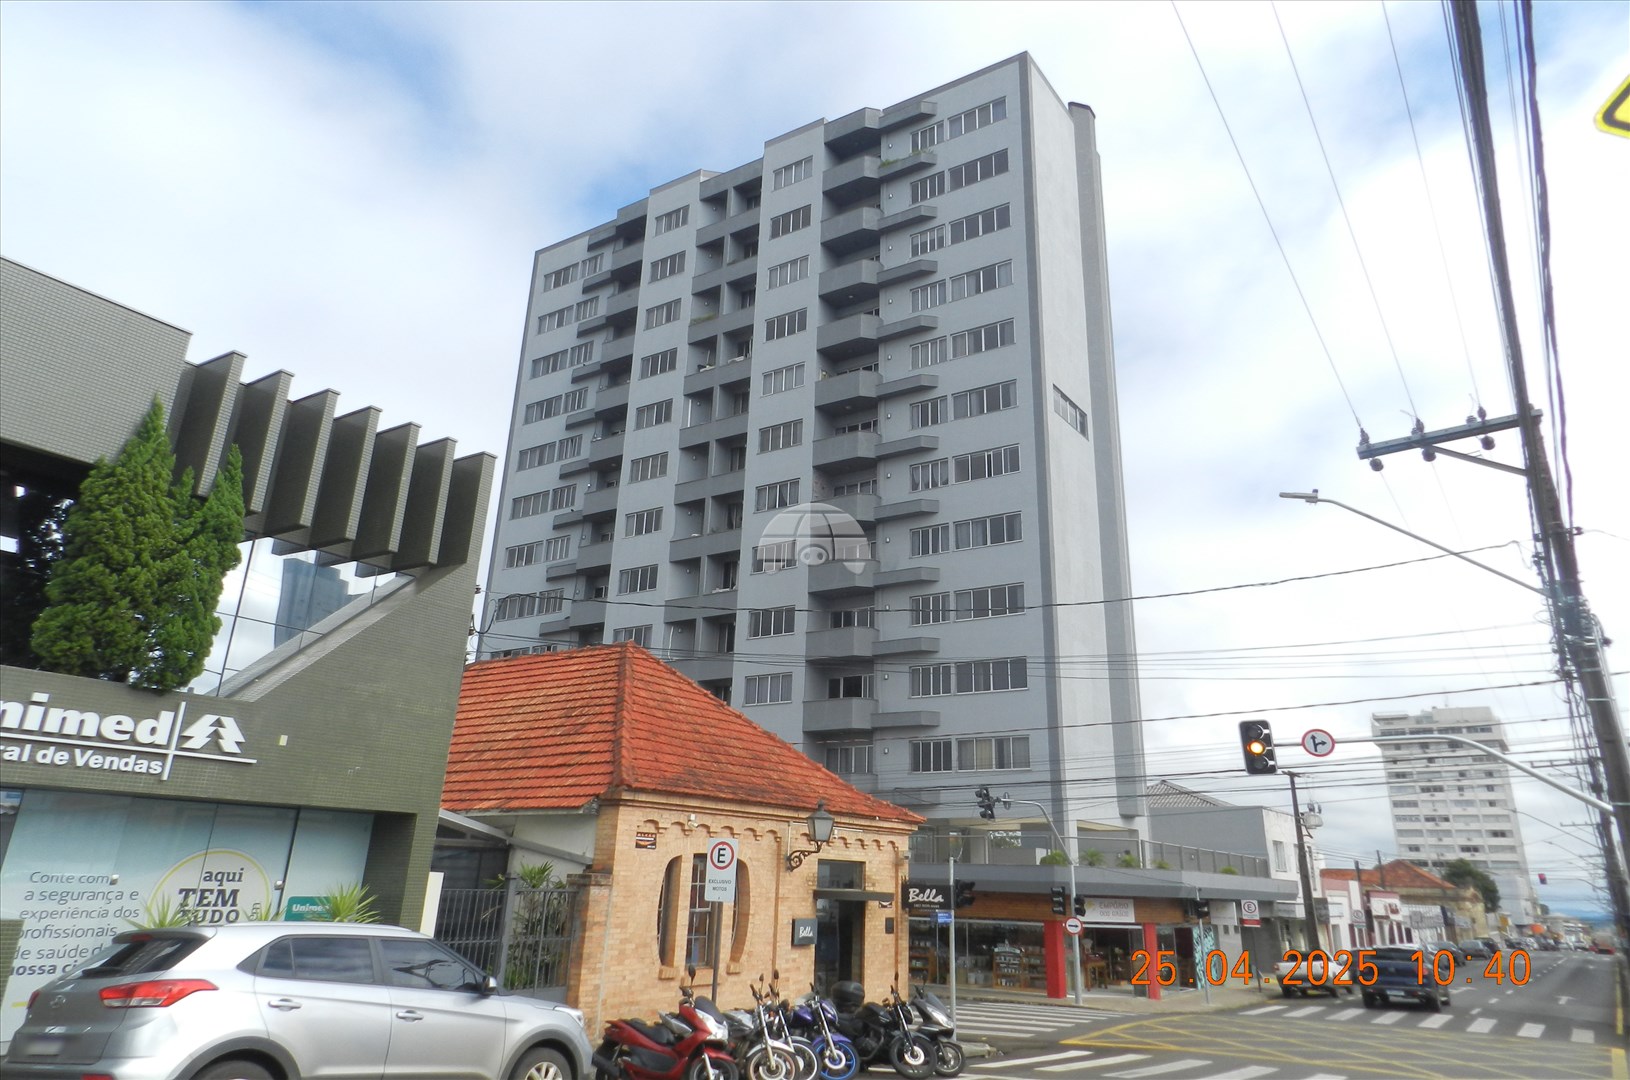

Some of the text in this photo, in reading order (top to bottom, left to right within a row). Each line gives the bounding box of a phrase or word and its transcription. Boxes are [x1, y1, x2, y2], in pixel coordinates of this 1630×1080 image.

[36, 747, 69, 765] de
[74, 748, 163, 775] Vendas
[717, 847, 727, 864] E
[30, 871, 110, 884] Conte com
[203, 868, 244, 886] aqui
[708, 878, 732, 886] EXCLUSIVO
[24, 889, 139, 905] a segurança e
[178, 888, 240, 908] TEM
[908, 888, 944, 903] Bella
[19, 906, 140, 922] experiência dos
[799, 926, 813, 938] Bella
[36, 944, 89, 960] saúde
